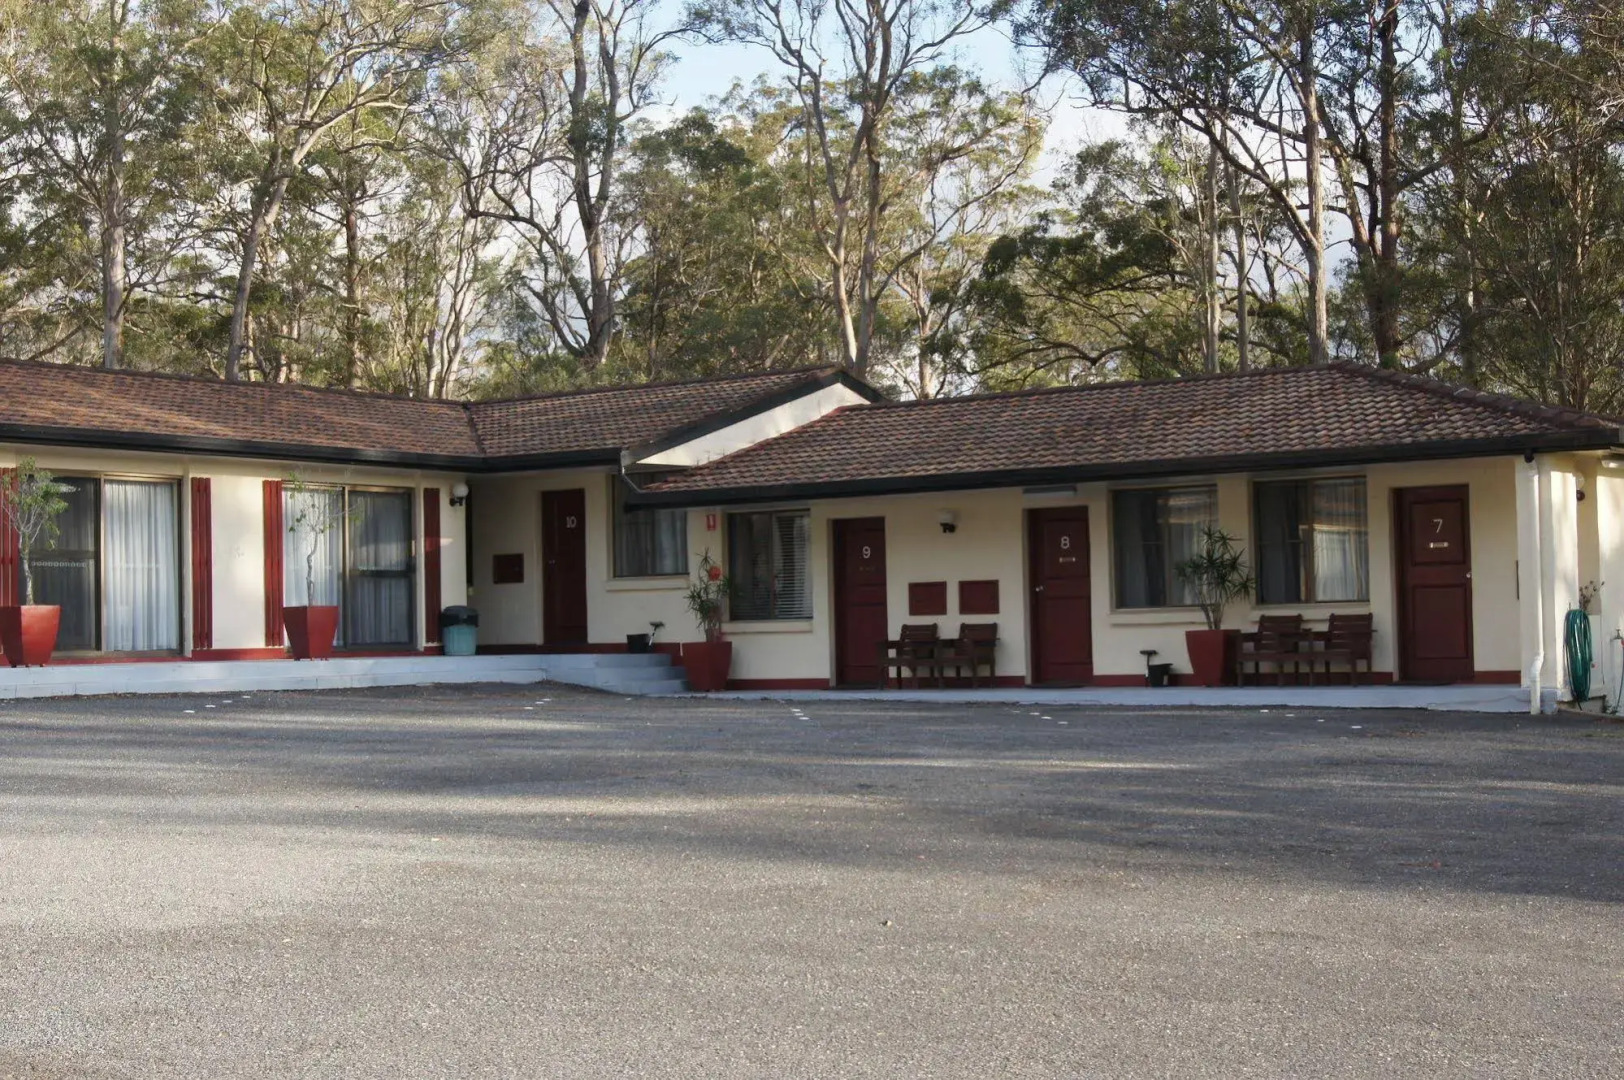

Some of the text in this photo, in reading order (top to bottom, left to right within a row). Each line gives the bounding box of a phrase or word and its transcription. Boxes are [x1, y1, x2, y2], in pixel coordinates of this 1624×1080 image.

[566, 516, 577, 529] 10
[1432, 518, 1443, 533] 7
[1060, 536, 1070, 549] 8
[862, 545, 871, 559] 9
